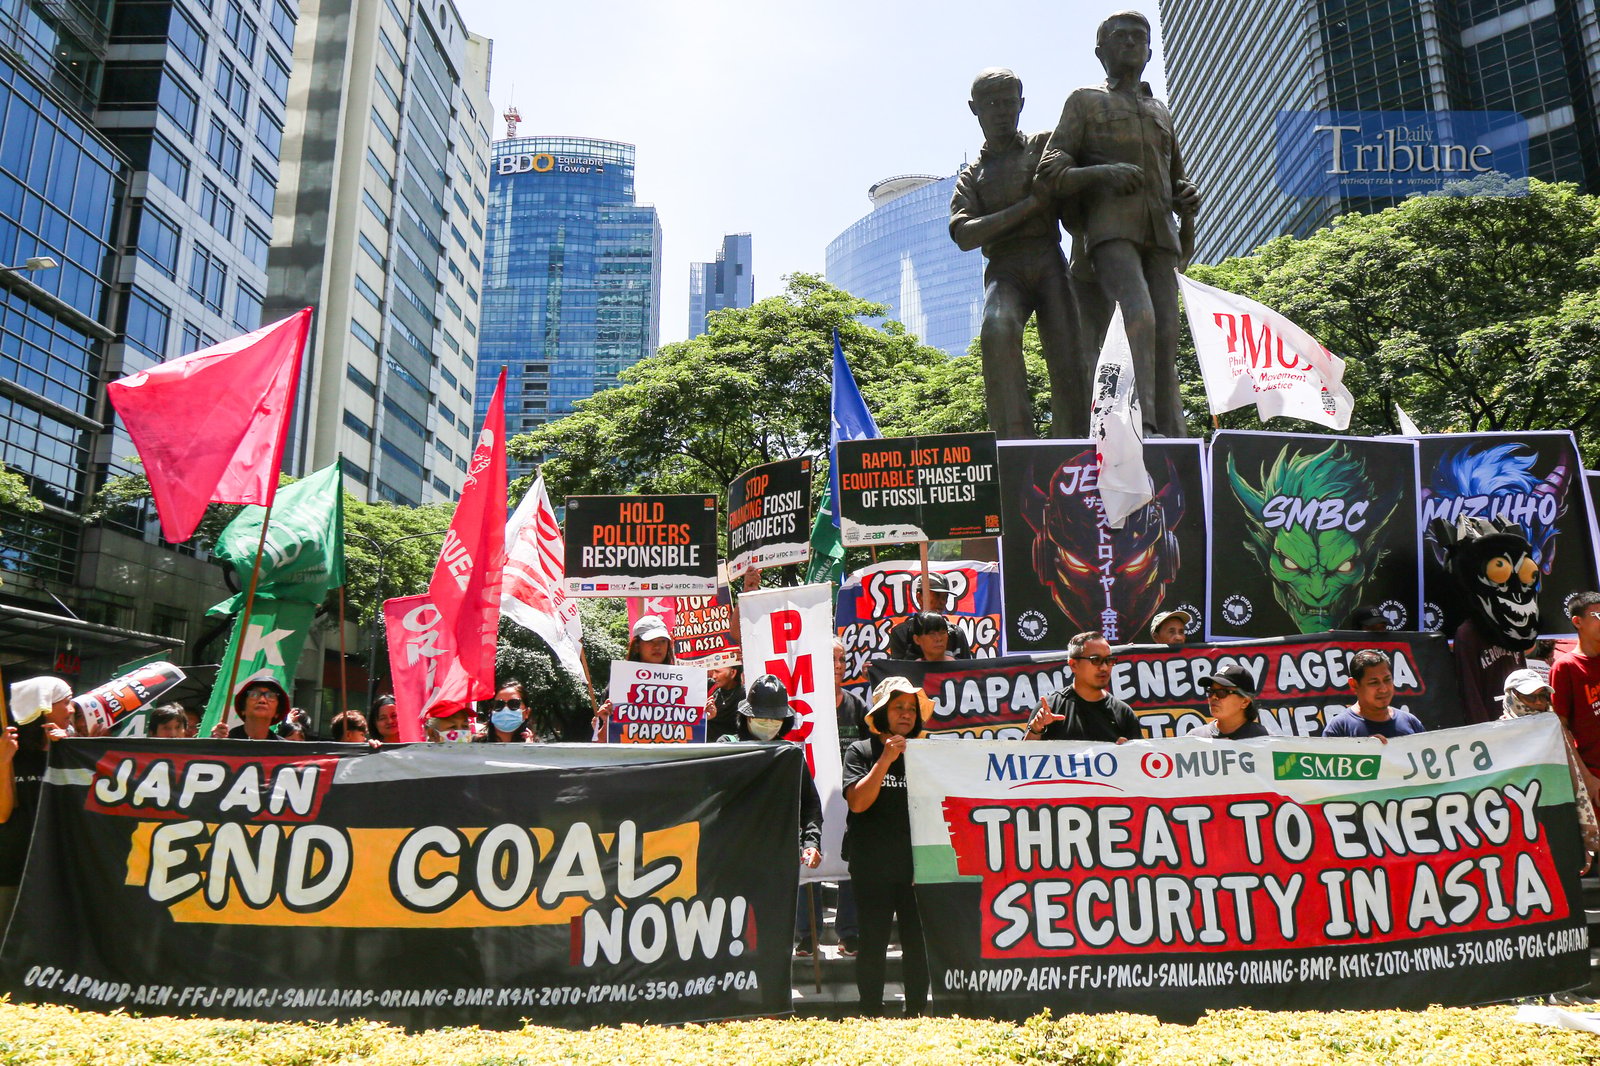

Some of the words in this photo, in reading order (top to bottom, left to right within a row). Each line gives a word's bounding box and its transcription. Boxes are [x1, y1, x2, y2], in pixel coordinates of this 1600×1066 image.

[498, 153, 554, 175] BDO
[558, 155, 604, 167] Equitable
[558, 164, 590, 173] Tower
[861, 450, 906, 469] RAPID,
[909, 448, 940, 467] JUST
[943, 446, 971, 464] AND
[745, 474, 769, 501] STOP
[842, 469, 915, 491] EQUITABLE
[918, 464, 993, 486] PHASE-OUT
[763, 490, 804, 516] FOSSIL
[862, 490, 879, 508] OF
[882, 487, 928, 507] FOSSIL
[930, 484, 976, 504] FUELS!
[619, 502, 664, 524] HOLD
[1263, 495, 1370, 532] SMBC
[1423, 493, 1558, 532] MIZUHO
[592, 523, 691, 546] POLLUTERS
[731, 526, 745, 551] FUEL
[745, 512, 796, 543] PROJECTS
[582, 545, 700, 568] RESPONSIBLE
[689, 612, 699, 624] &
[702, 606, 729, 622] LNG
[678, 640, 691, 653] IN
[695, 636, 724, 651] ASIA
[843, 620, 891, 651] GAS
[653, 672, 683, 681] MUFG
[1278, 649, 1418, 691] AGEA
[635, 684, 683, 704] STOP
[618, 706, 698, 723] FUNDING
[628, 723, 685, 740] PAPUA
[985, 752, 1118, 781] MIZUHO
[1176, 749, 1255, 778] MUFG
[1300, 755, 1374, 778] SMBC
[95, 758, 320, 816] JAPAN
[973, 805, 1211, 872] THREAT
[1230, 802, 1313, 865] TO
[1324, 780, 1540, 858] ENERGY
[149, 820, 349, 907] END
[397, 819, 677, 908] COAL
[992, 873, 1302, 948] SECURITY
[1320, 867, 1391, 938] IN
[1409, 853, 1552, 929] ASIA
[582, 895, 747, 968] NOW!
